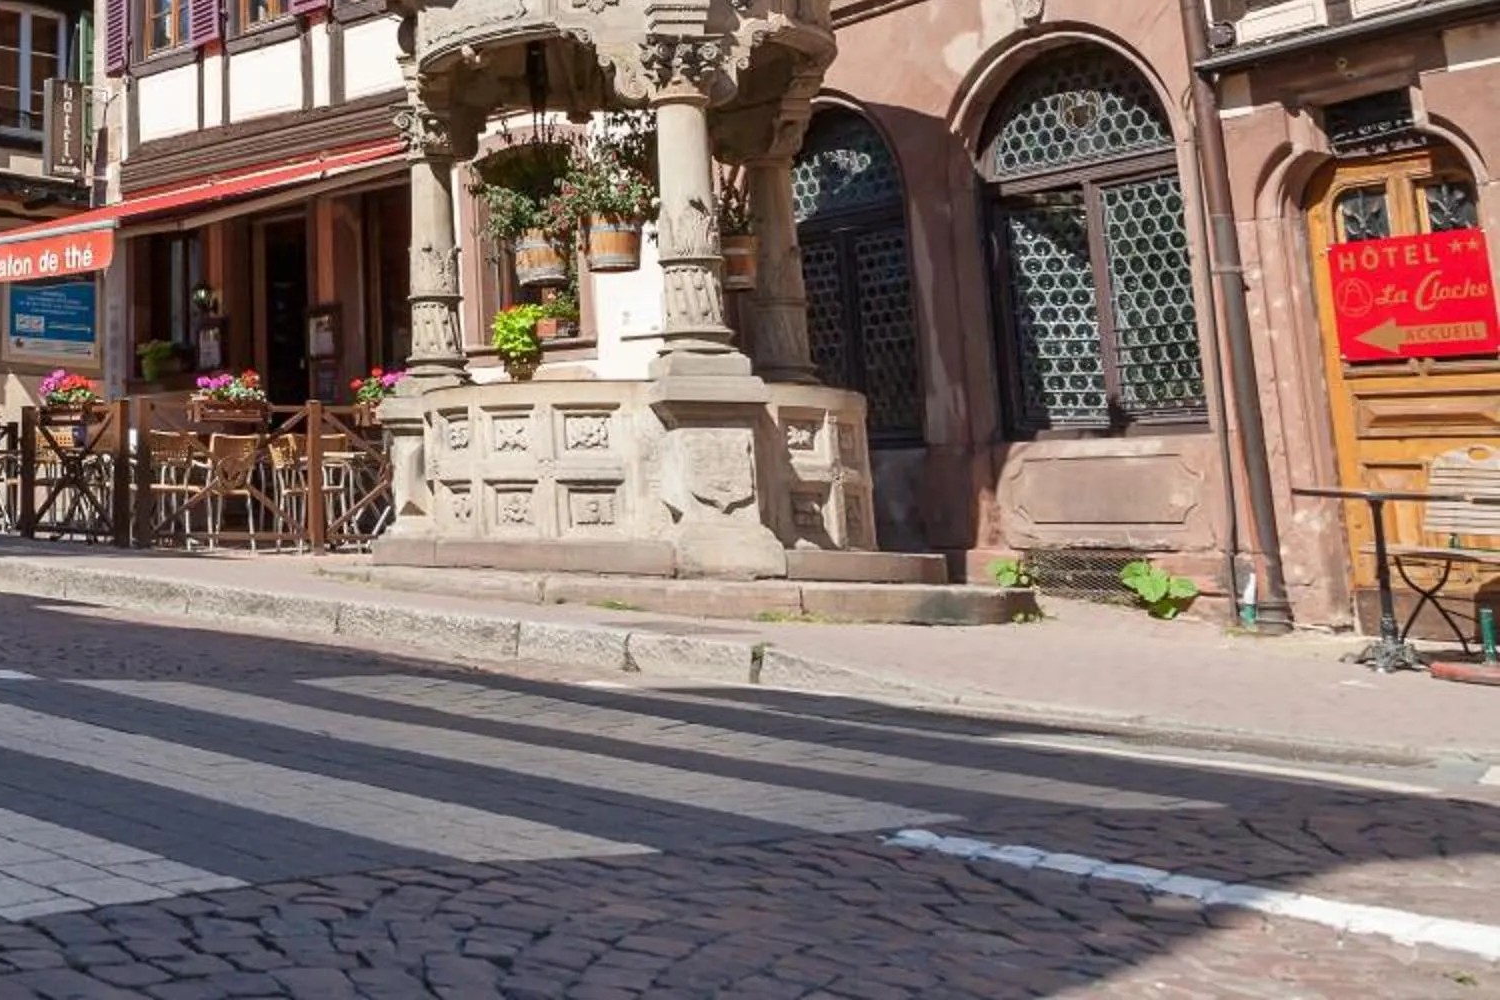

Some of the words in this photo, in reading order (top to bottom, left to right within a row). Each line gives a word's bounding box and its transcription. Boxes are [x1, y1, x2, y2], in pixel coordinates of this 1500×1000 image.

[39, 249, 59, 273] de
[65, 241, 93, 268] thé
[1338, 242, 1439, 272] HÔTEL
[1415, 270, 1488, 312] Cloche
[1406, 324, 1480, 341] ACCUEIL
